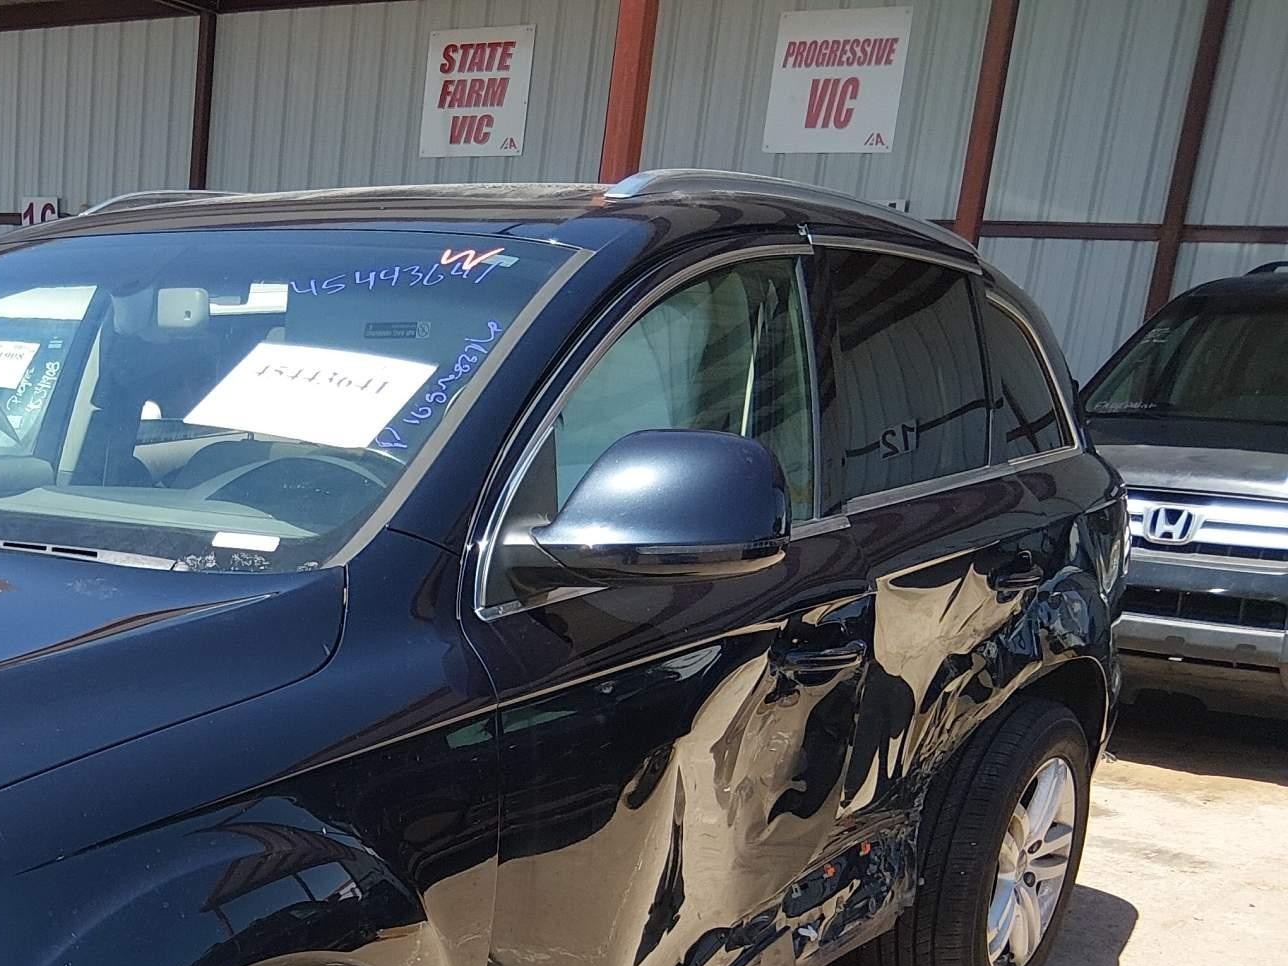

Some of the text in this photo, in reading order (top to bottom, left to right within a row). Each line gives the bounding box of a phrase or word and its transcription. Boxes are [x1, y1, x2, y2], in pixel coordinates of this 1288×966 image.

[440, 42, 516, 74] STATE
[782, 38, 899, 68] PROGRESSIVE
[438, 78, 510, 109] FARM
[805, 77, 860, 129] VIC
[450, 114, 494, 145] VIC
